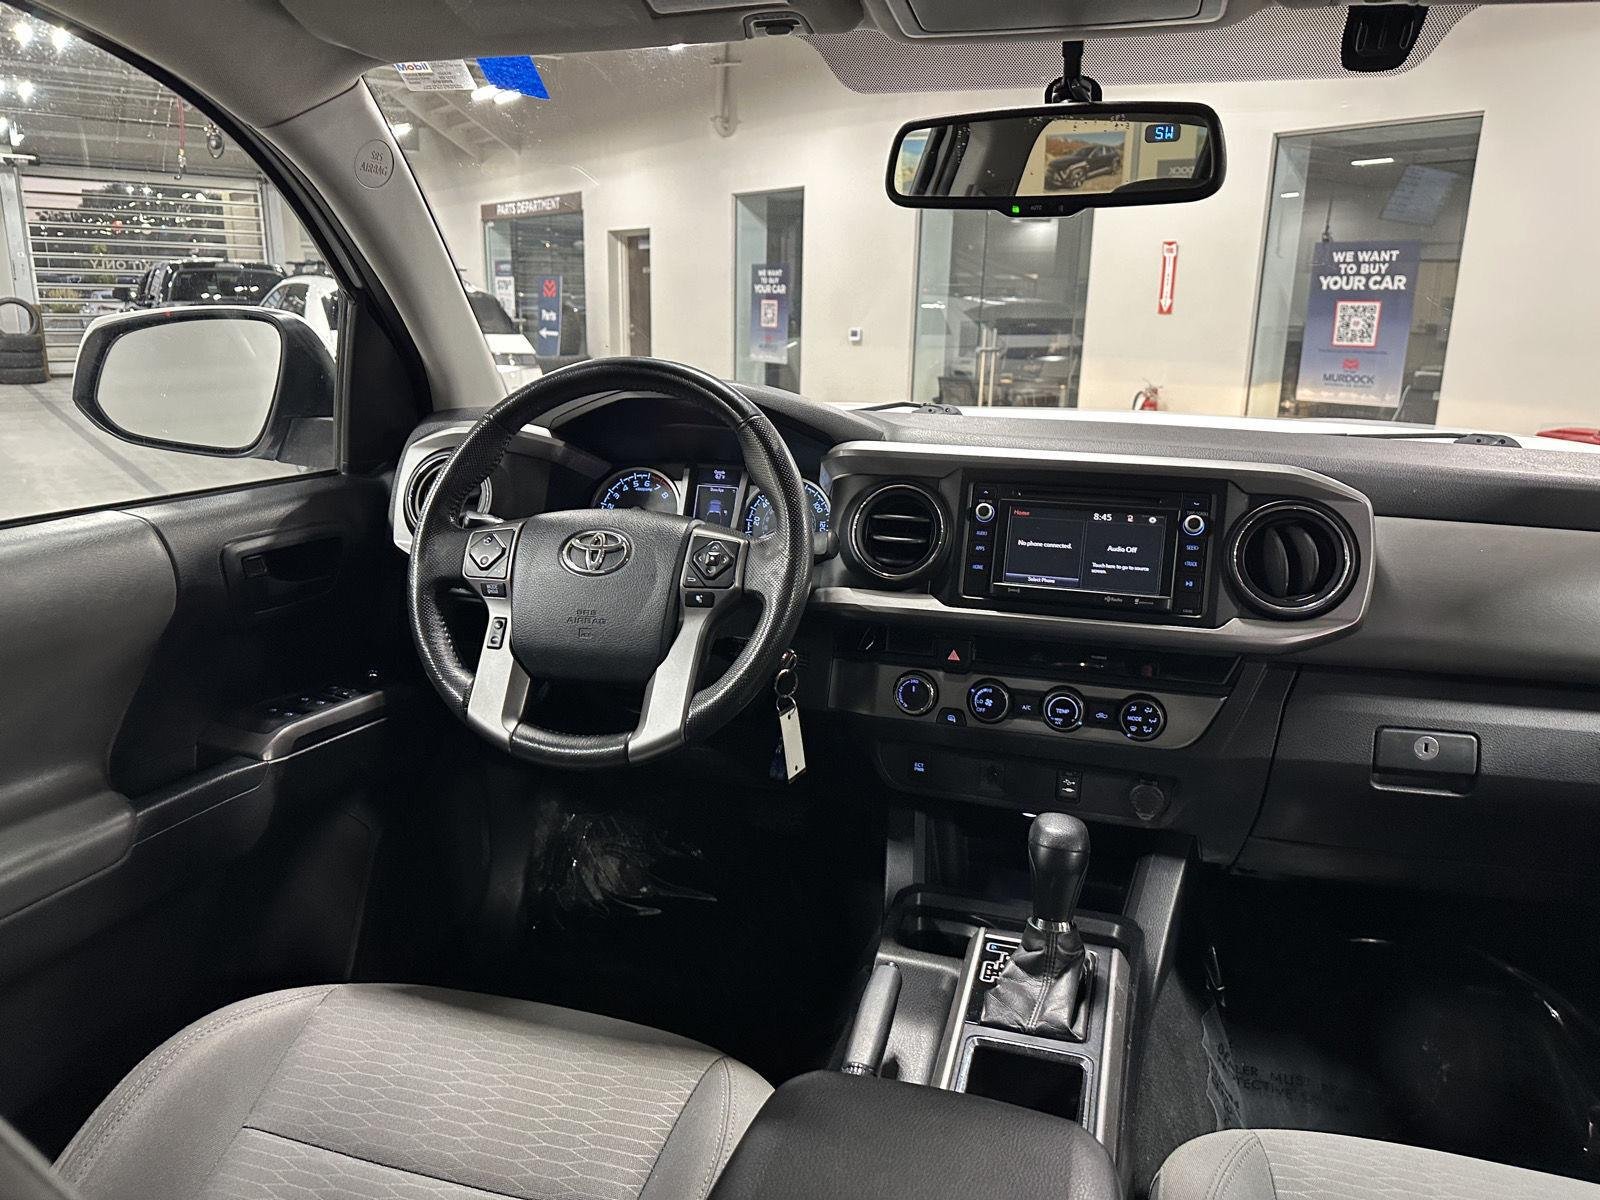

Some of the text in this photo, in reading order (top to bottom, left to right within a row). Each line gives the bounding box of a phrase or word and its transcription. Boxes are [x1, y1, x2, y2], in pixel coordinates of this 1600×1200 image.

[396, 63, 429, 71] Mobil
[1154, 126, 1174, 140] SW
[496, 196, 561, 216] PARTS DEPARTMENT
[1332, 250, 1400, 262] WE WANT
[758, 268, 784, 277] WE WANT
[1339, 263, 1390, 274] TO BUY
[1319, 274, 1407, 290] YOUR CAR
[754, 284, 787, 295] YOUR CAR
[541, 309, 557, 321] Parts
[1322, 373, 1376, 385] MURDOCK
[622, 484, 629, 492] 4
[633, 480, 639, 488] 5
[612, 492, 620, 500] 3
[661, 491, 669, 499] 8
[812, 501, 824, 514] 100
[753, 516, 761, 526] 20
[1093, 512, 1112, 522] 8:45
[1017, 539, 1072, 550] No phone connected.
[1107, 545, 1138, 554] Audio Off
